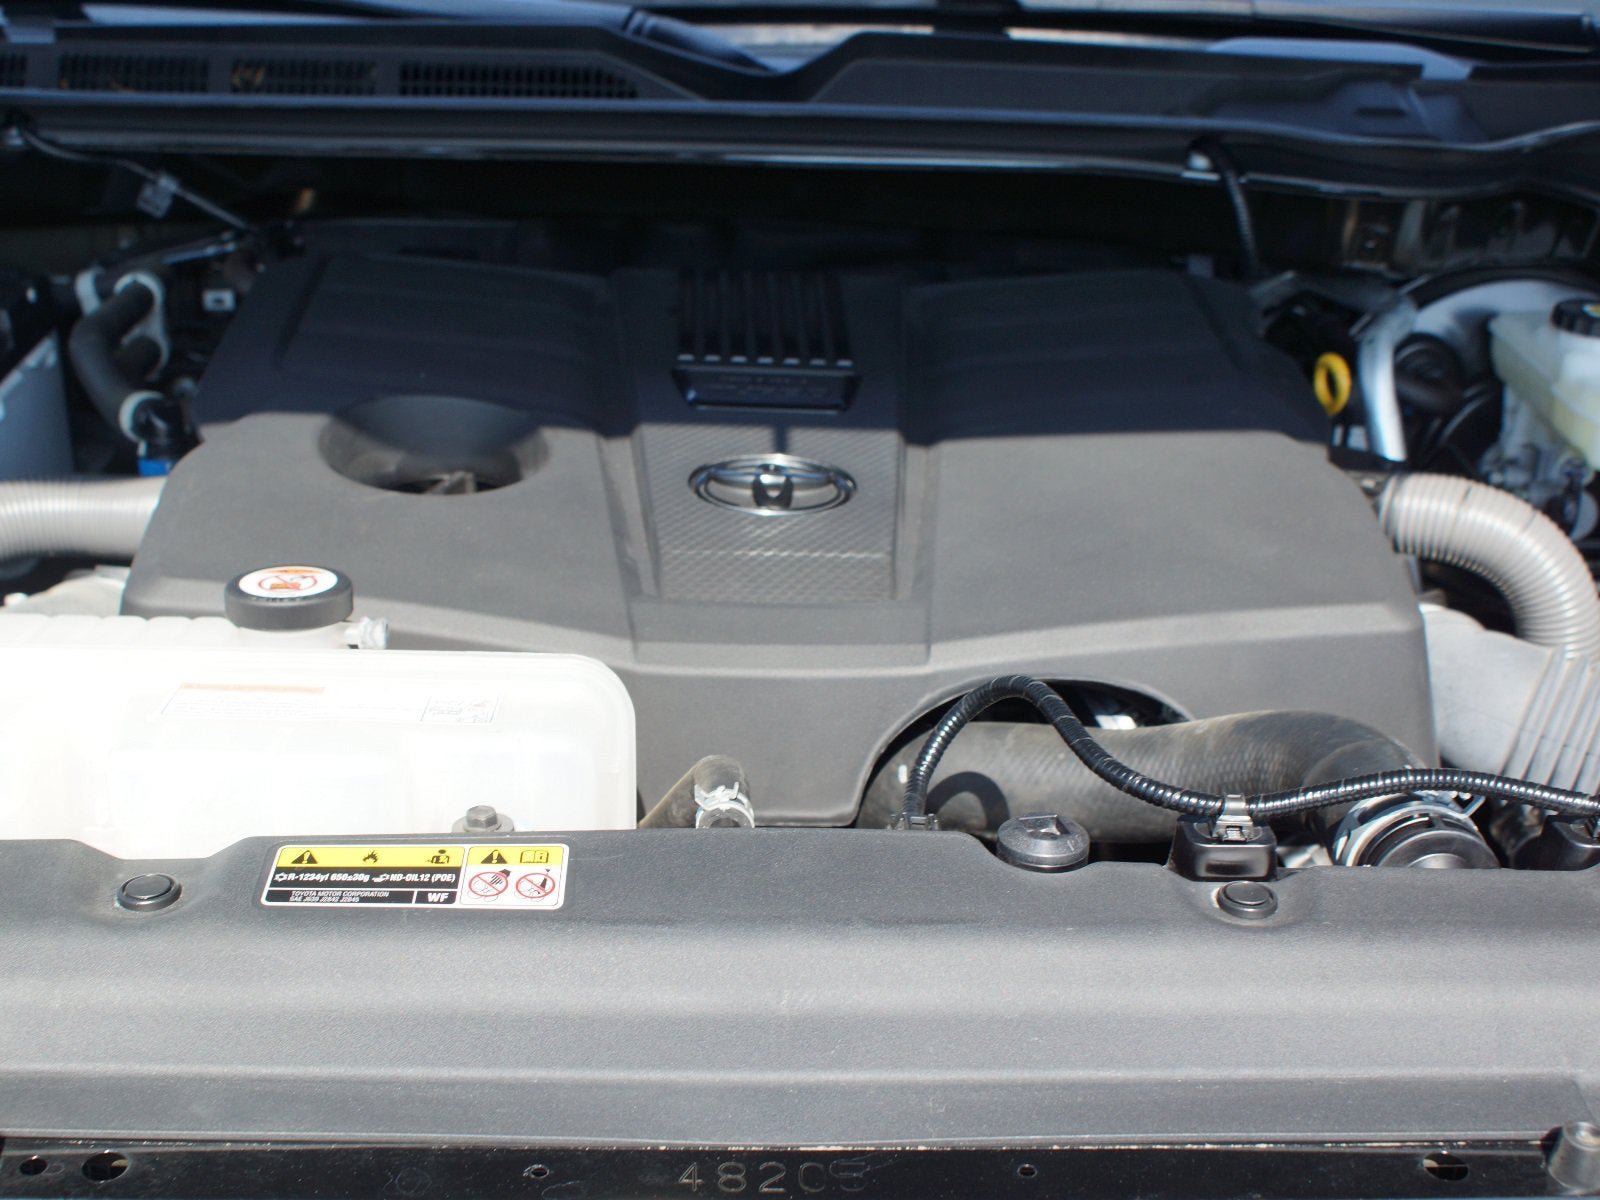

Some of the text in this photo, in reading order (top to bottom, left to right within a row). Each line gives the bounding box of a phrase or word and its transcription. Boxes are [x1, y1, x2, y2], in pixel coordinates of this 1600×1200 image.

[389, 873, 430, 882] ND-OIL12
[431, 873, 456, 883] (POE)
[342, 890, 390, 898] CORPORATION
[427, 892, 450, 902] WF
